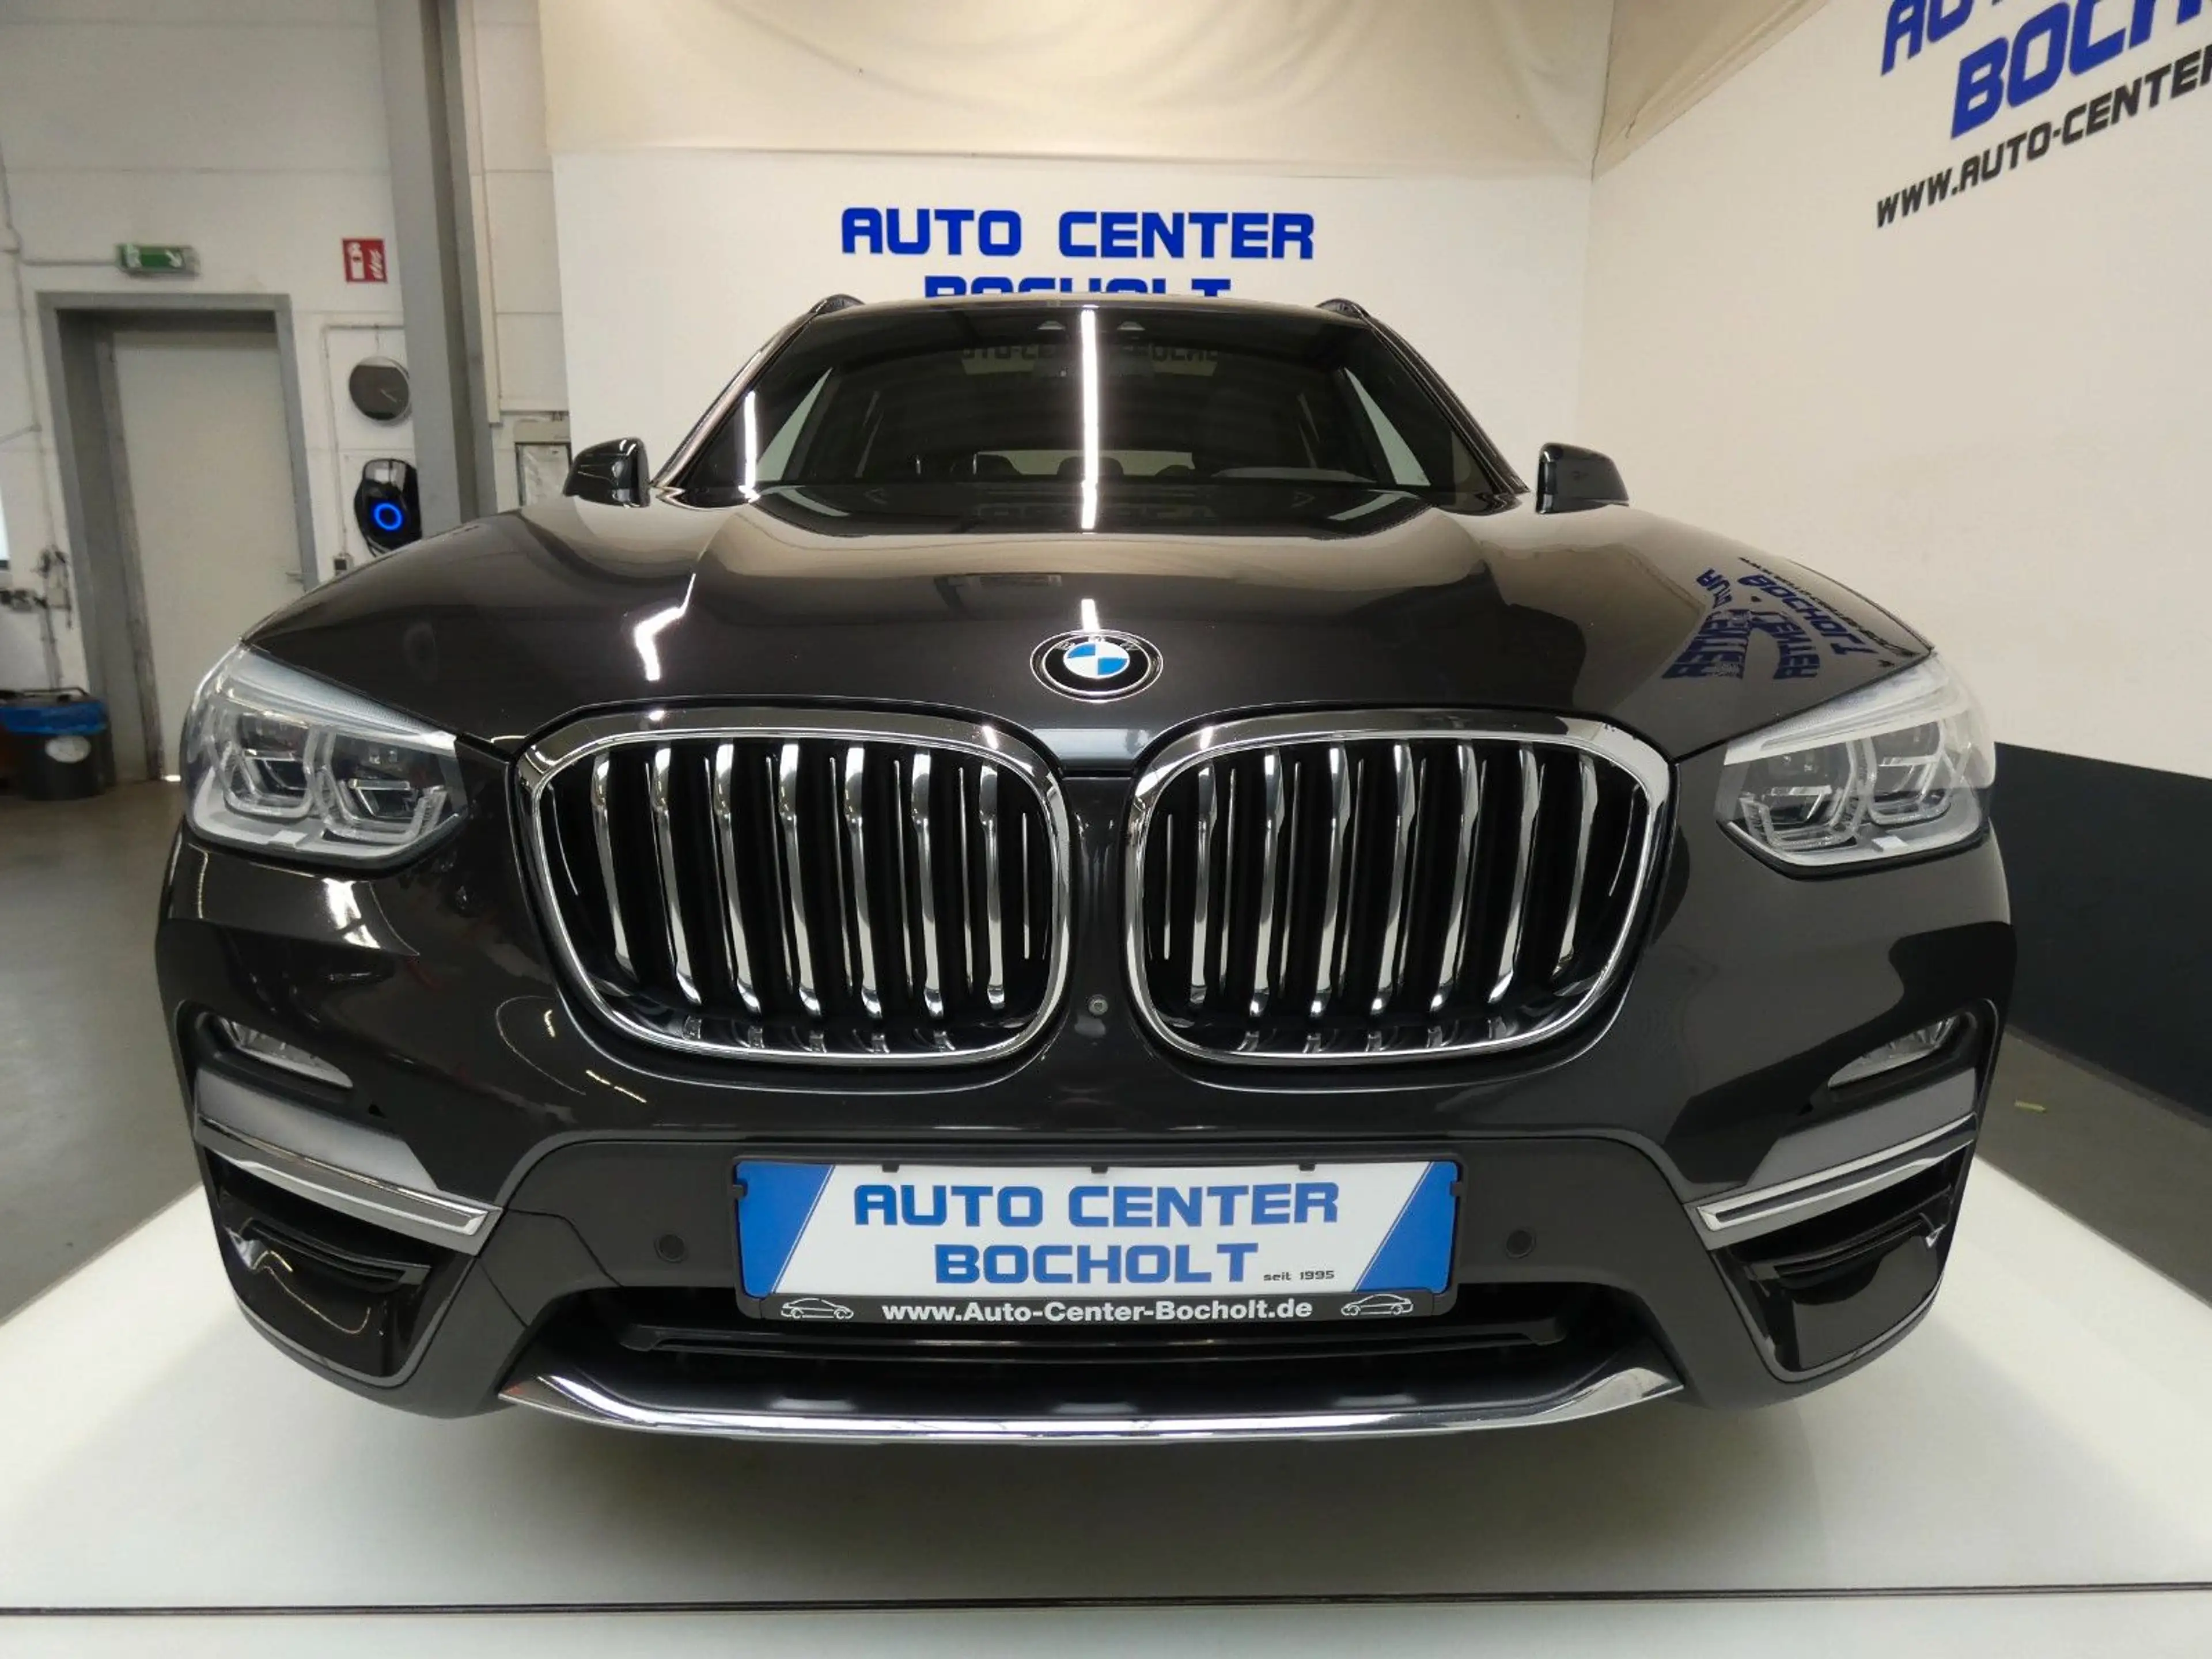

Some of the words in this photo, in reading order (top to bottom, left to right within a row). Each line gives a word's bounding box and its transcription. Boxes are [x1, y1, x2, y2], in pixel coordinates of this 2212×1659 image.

[841, 207, 1022, 257] AUTO
[1058, 210, 1314, 260] CENTER
[854, 1183, 1044, 1228] AUTO
[1068, 1181, 1339, 1228] CENTER
[934, 1243, 1257, 1284] BOCHOLT
[1263, 1271, 1291, 1281] seit
[1300, 1270, 1335, 1280] 1995
[882, 1297, 1313, 1322] www.Auto-Center-Bocholt.de
